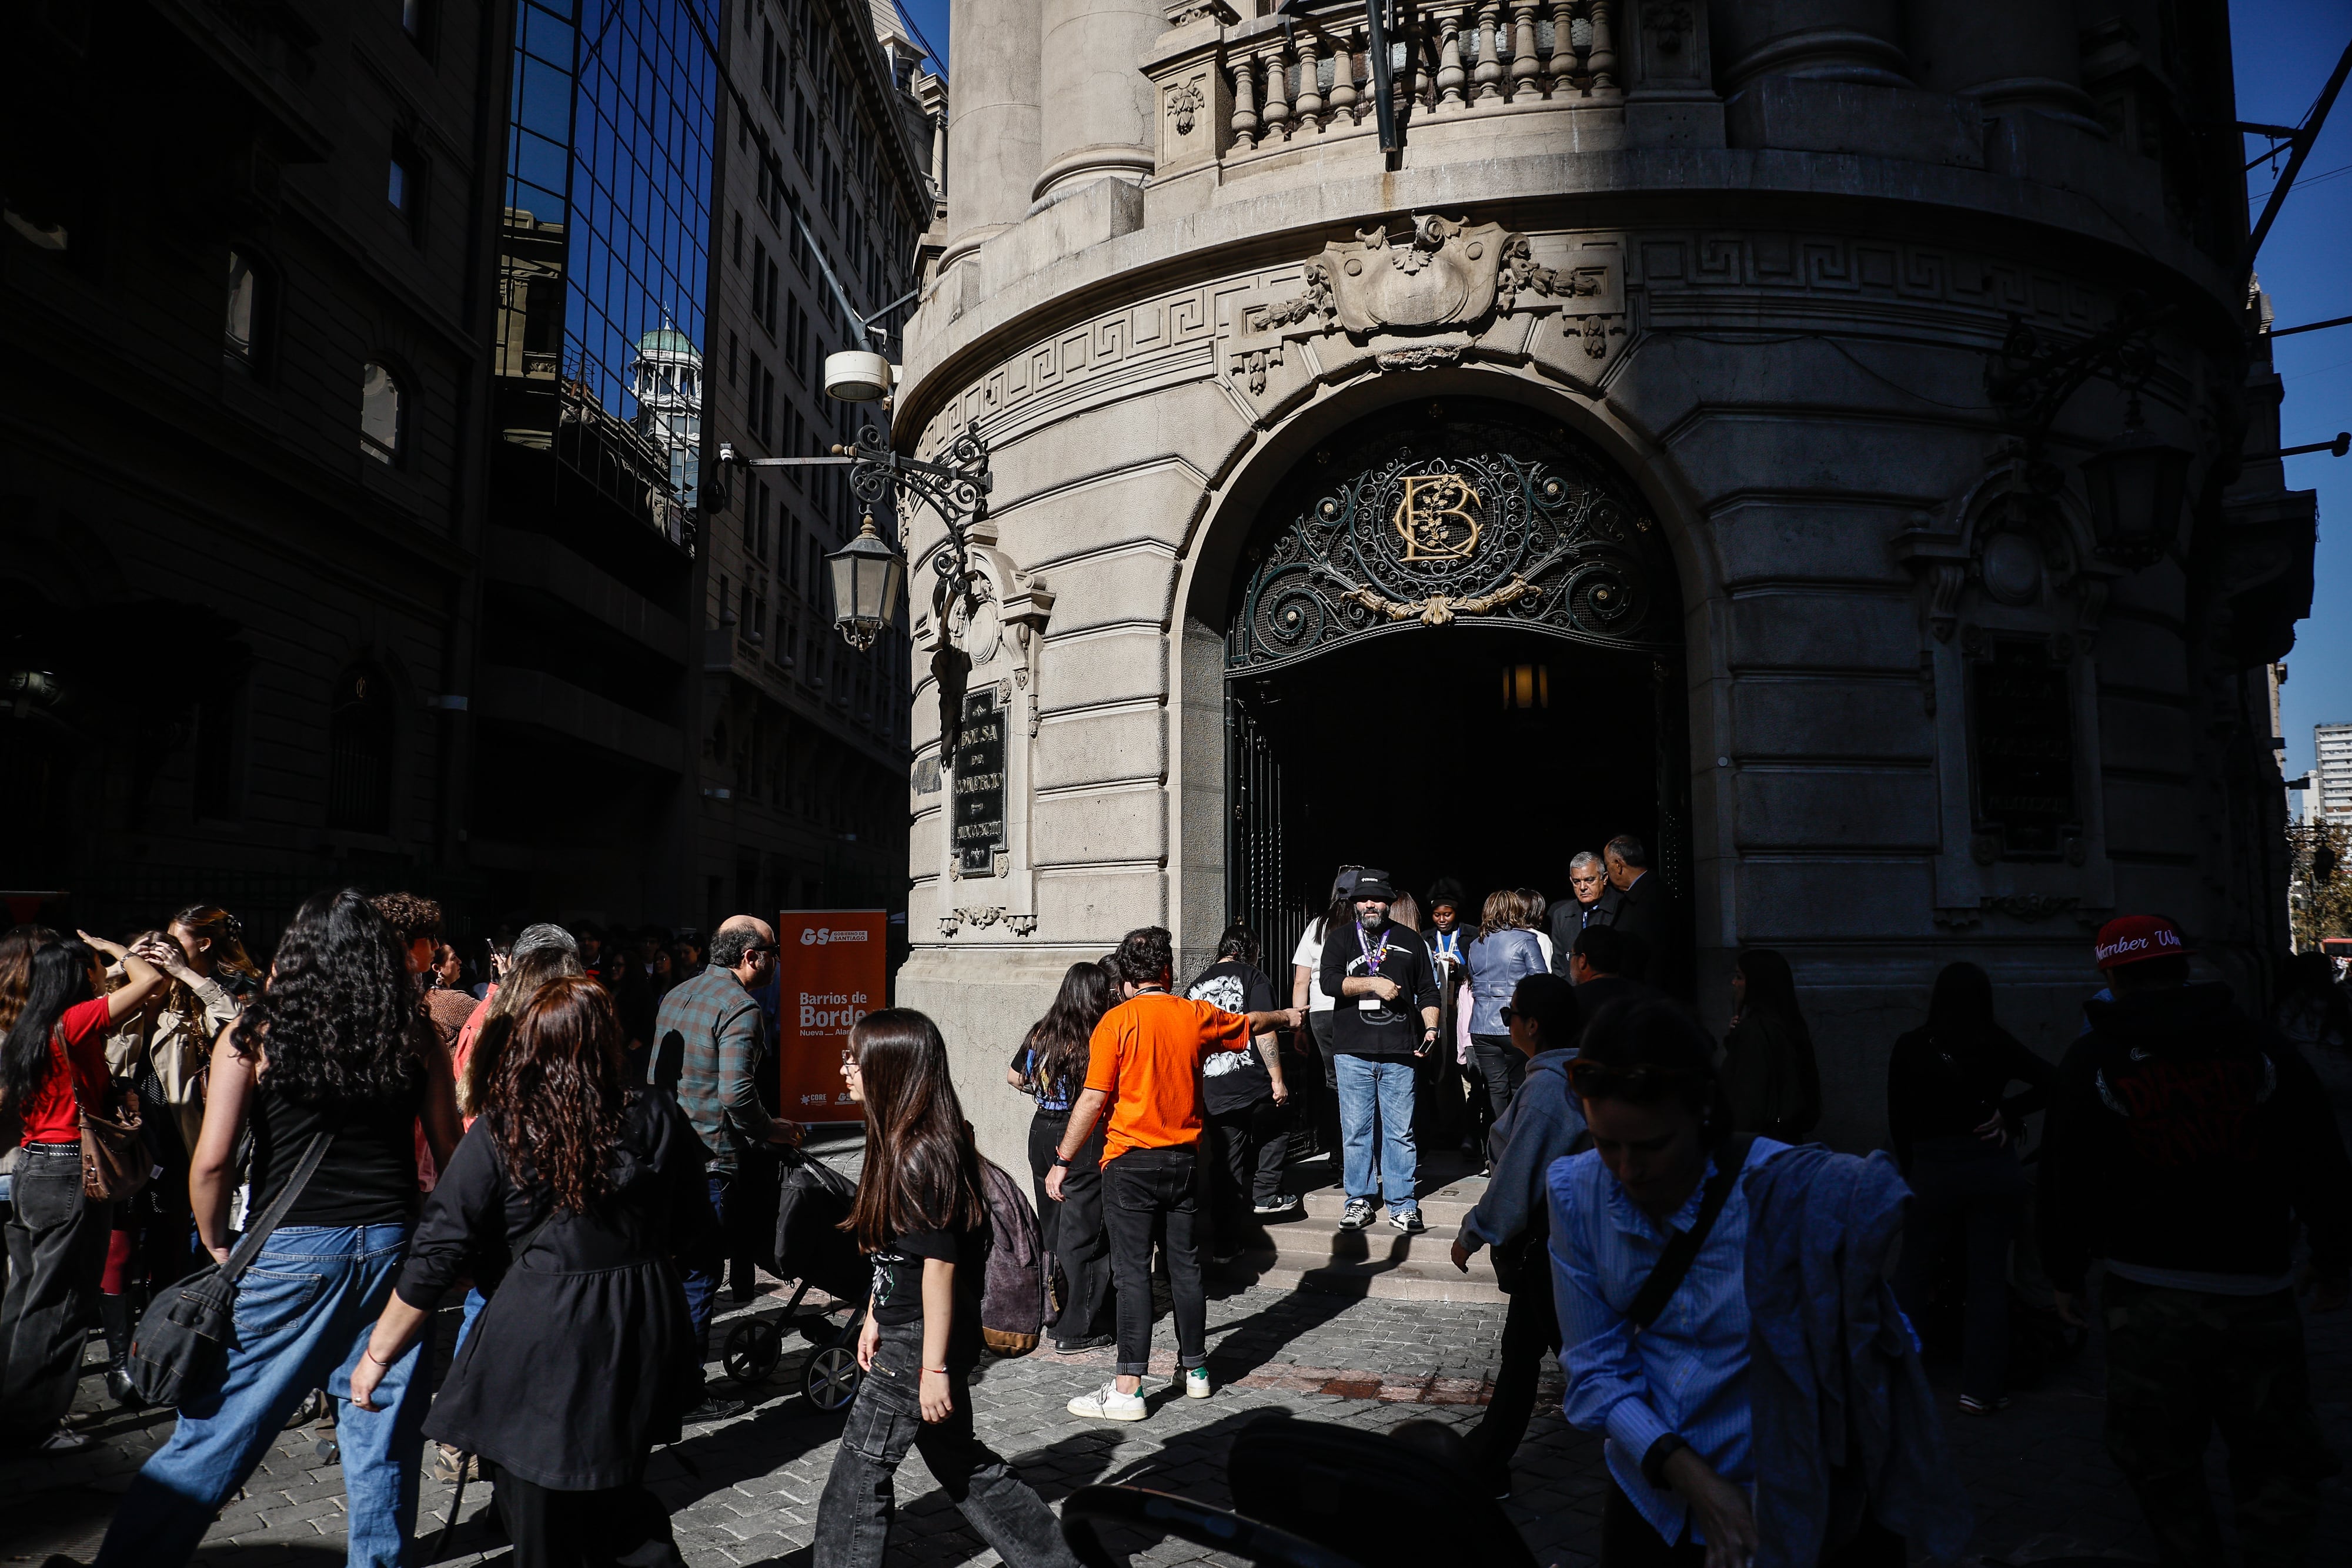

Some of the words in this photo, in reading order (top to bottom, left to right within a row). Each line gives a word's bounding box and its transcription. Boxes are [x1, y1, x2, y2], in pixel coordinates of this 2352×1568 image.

[961, 724, 998, 748] BOLSA
[971, 754, 984, 765] DE
[956, 773, 1003, 794] COMERCIO
[800, 928, 830, 945] GS
[2094, 937, 2149, 963] Number
[800, 992, 847, 1005] Barrios
[851, 991, 867, 1004] de
[800, 1005, 867, 1027] Borde
